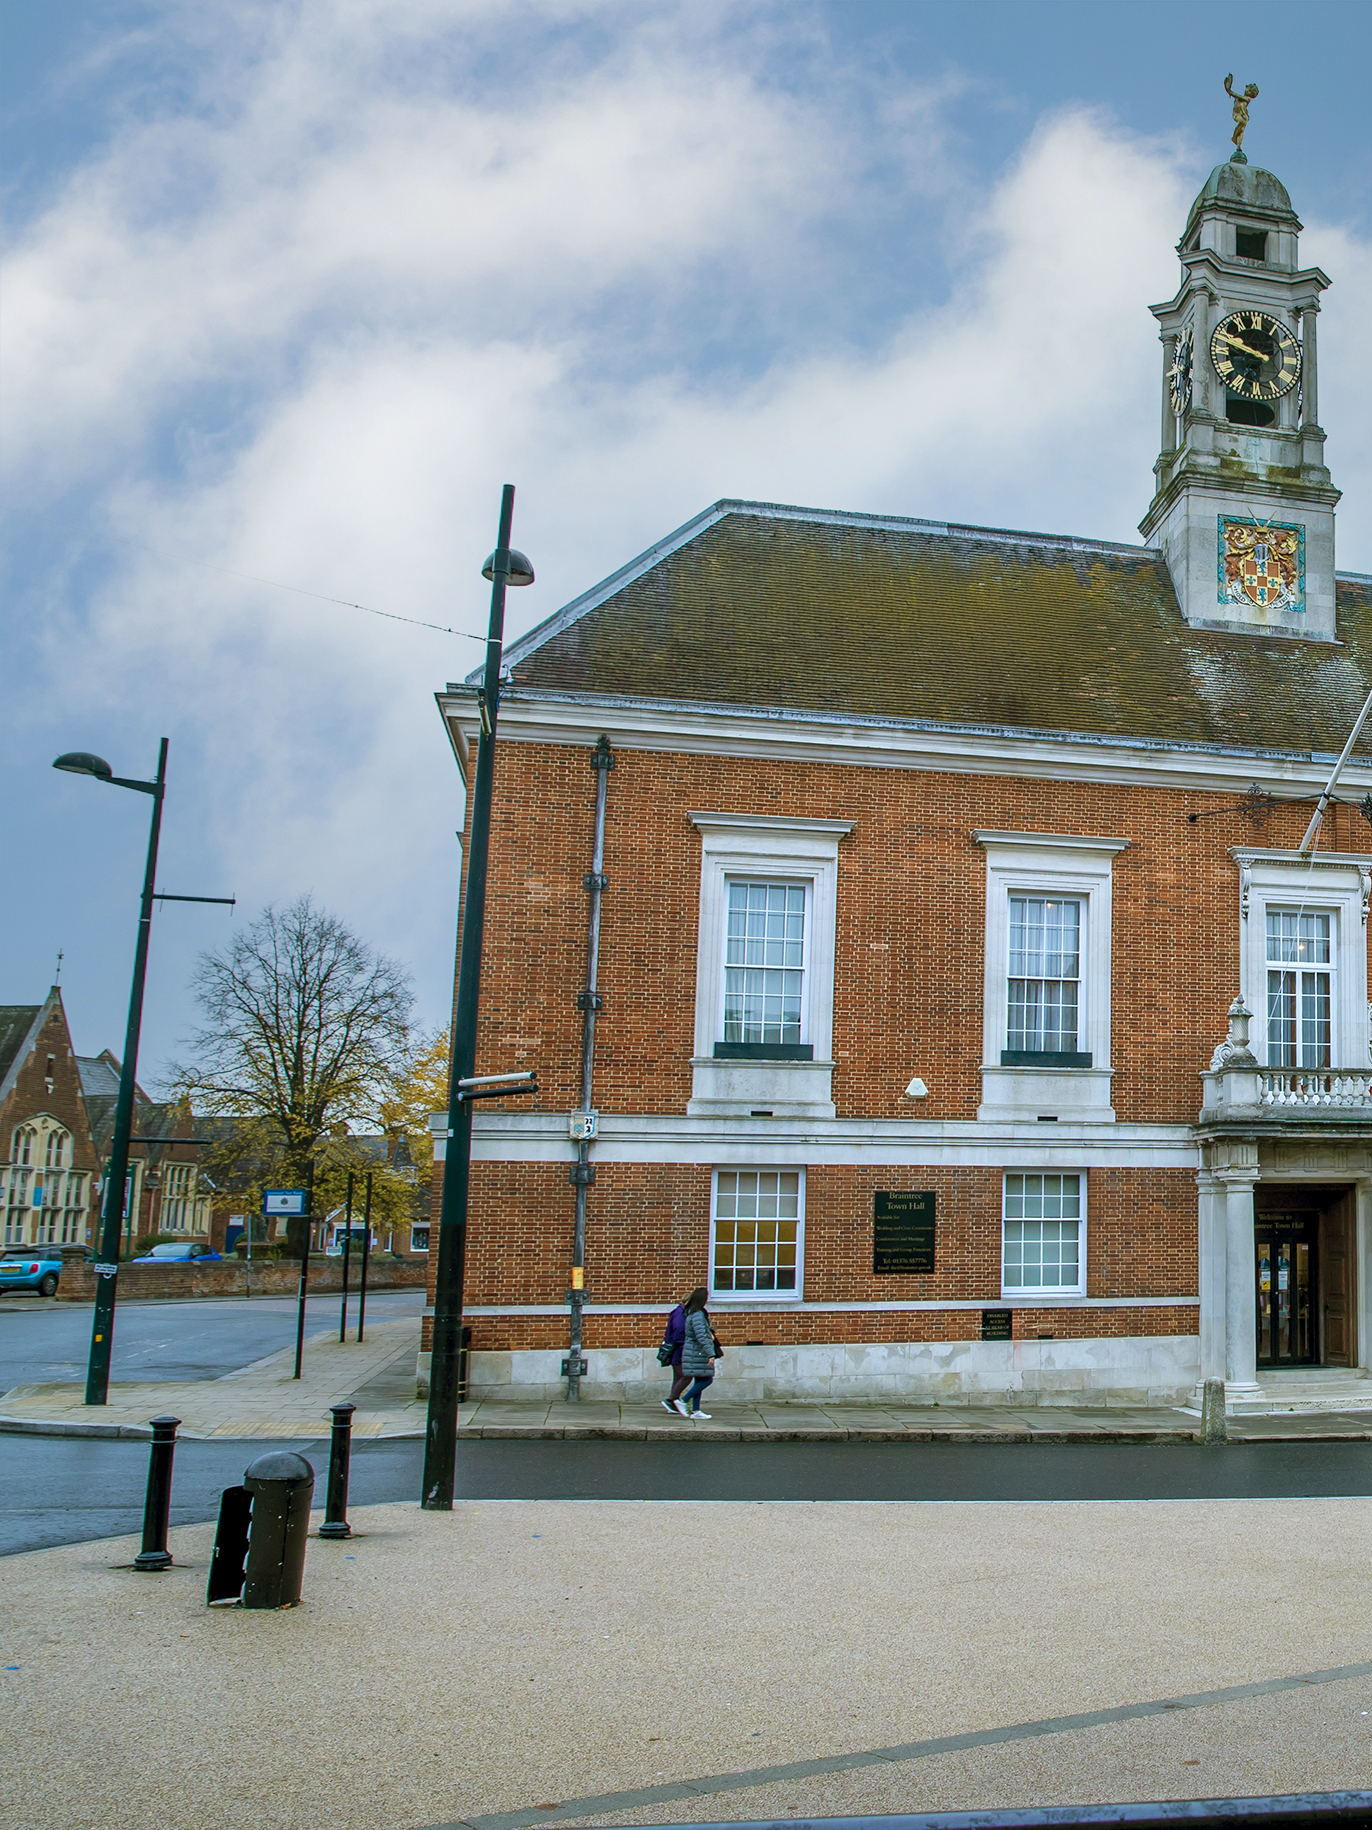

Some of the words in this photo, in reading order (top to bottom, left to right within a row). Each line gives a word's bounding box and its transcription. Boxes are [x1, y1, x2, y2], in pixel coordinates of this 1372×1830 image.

[1233, 317, 1246, 332] XI
[1251, 316, 1262, 330] XII
[1269, 324, 1278, 336] I
[1216, 344, 1229, 356] IX
[1279, 339, 1292, 349] II
[1218, 360, 1234, 376] VIII
[1232, 374, 1246, 391] VII
[1252, 382, 1261, 395] VI
[1269, 380, 1280, 394] V
